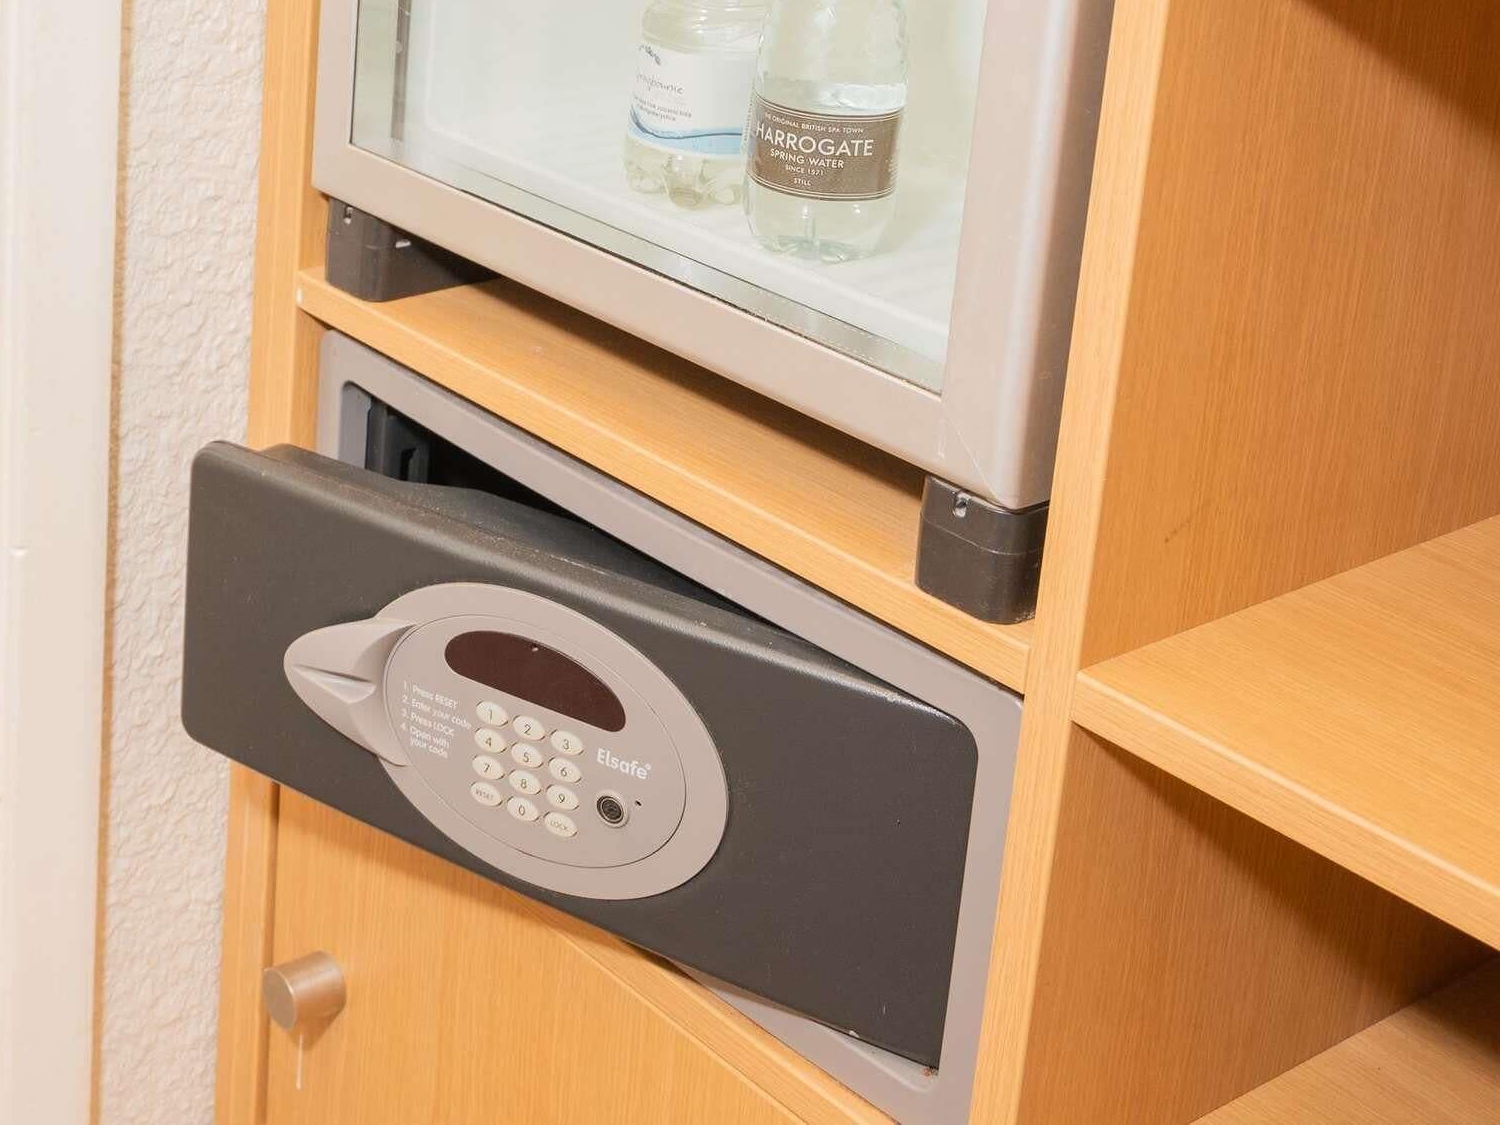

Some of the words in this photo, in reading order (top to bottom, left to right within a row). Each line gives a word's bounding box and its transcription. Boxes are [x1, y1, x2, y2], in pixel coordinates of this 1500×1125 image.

[771, 115, 800, 128] ORIGINAL
[801, 123, 826, 133] BRITISH
[828, 126, 841, 134] SPA
[756, 121, 875, 156] HARROGATE
[770, 148, 805, 165] SPRING
[808, 157, 845, 169] WATER
[785, 164, 804, 174] SINCE
[793, 177, 812, 186] STILL
[435, 694, 458, 710] RESET
[411, 698, 432, 713] Enter
[432, 709, 450, 722] your
[451, 716, 472, 730] code
[411, 712, 432, 728] Press
[433, 721, 455, 738] LOCK
[524, 724, 532, 735] 2
[410, 725, 432, 742] Open
[433, 735, 451, 749] with
[485, 737, 493, 748] 4
[410, 735, 428, 751] your
[428, 744, 449, 759] code
[562, 739, 570, 750] 3
[523, 752, 530, 763] 5
[483, 763, 491, 773] 7
[560, 766, 568, 777] 6
[520, 778, 528, 790] 8
[475, 789, 494, 801] RESET
[558, 793, 566, 804] 9
[518, 805, 526, 816] 0
